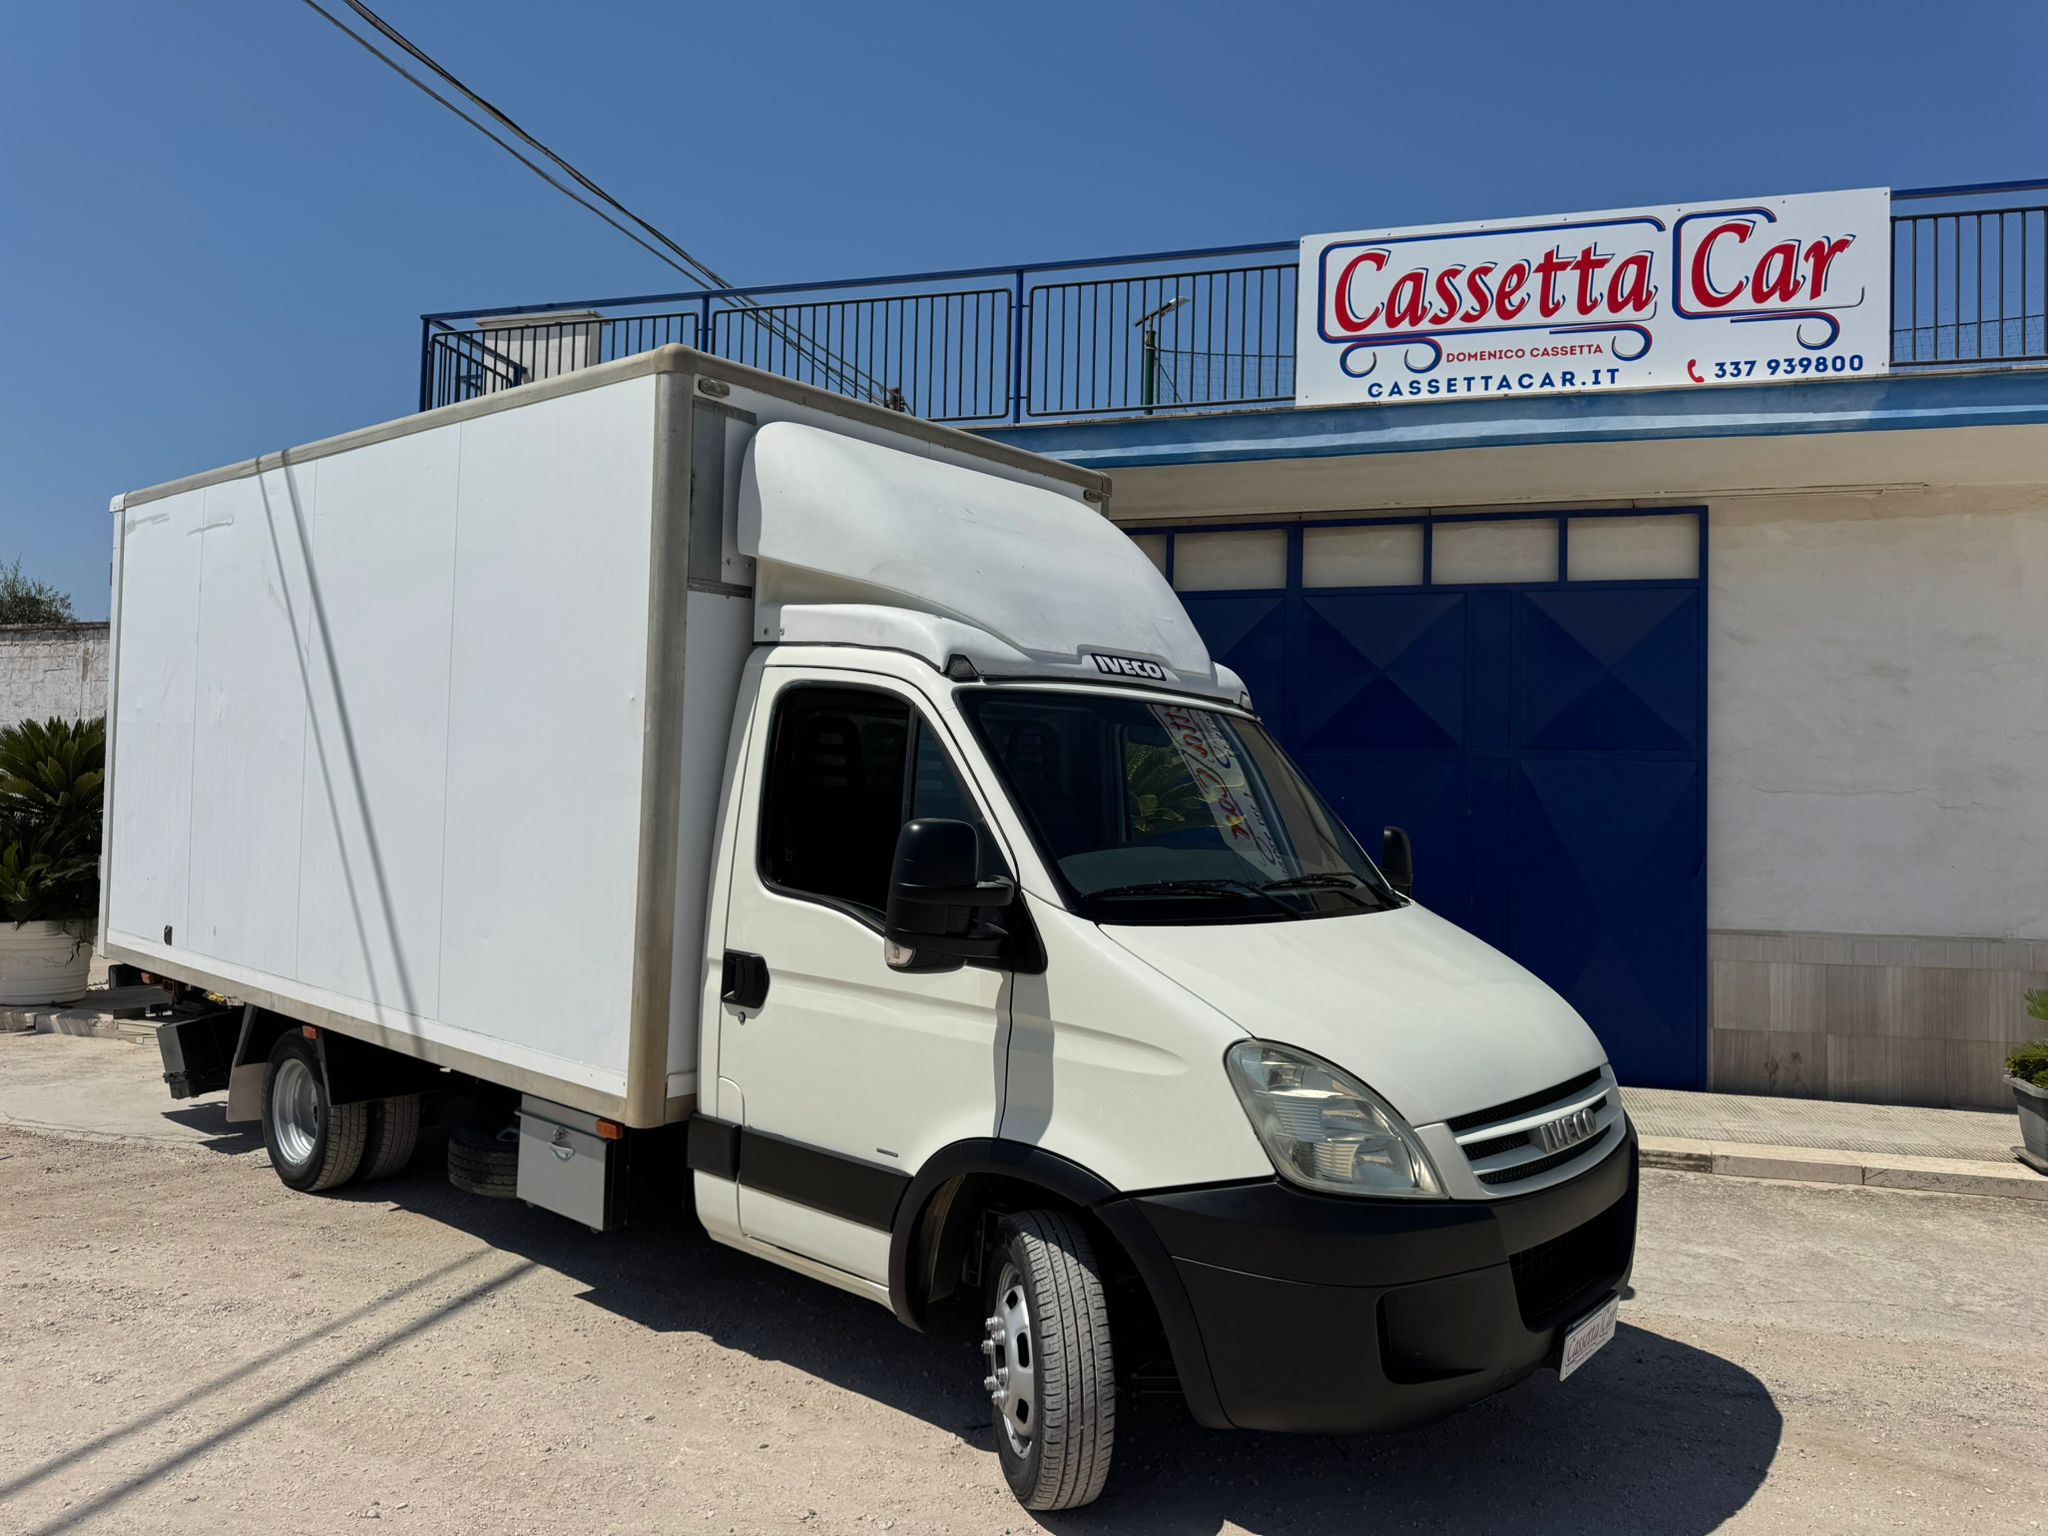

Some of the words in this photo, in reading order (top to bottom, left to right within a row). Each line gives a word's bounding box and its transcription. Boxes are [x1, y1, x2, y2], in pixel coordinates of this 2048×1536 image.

[1333, 241, 1657, 333] Cassetta
[1691, 218, 1856, 308] Car
[1446, 348, 1525, 363] DOMENICO
[1530, 343, 1603, 358] CASSETTA
[1714, 360, 1757, 379] 337
[1766, 354, 1864, 376] 939800
[1367, 368, 1620, 398] CASSETTACAR.IT
[1094, 655, 1163, 679] IVECO
[1539, 1108, 1597, 1154] IVECO
